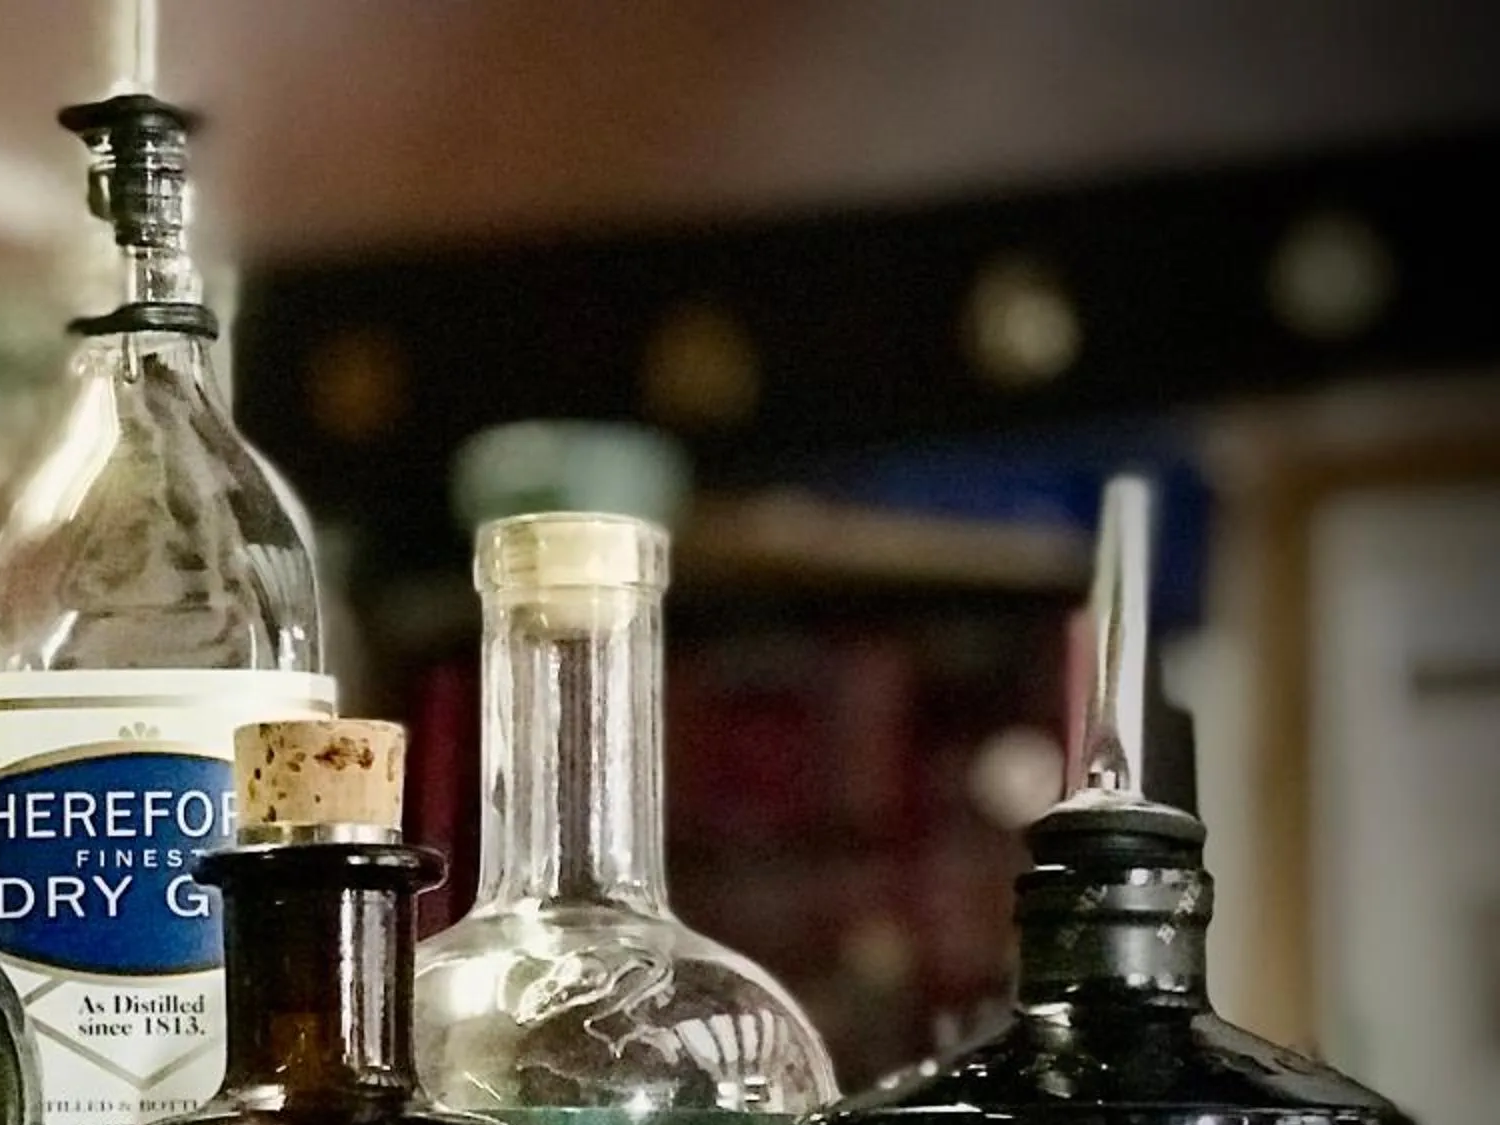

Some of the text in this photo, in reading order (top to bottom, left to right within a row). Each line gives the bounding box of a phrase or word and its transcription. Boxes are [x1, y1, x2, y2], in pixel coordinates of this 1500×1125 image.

[78, 993, 206, 1015] As Distilled
[78, 1016, 206, 1037] since 1813.
